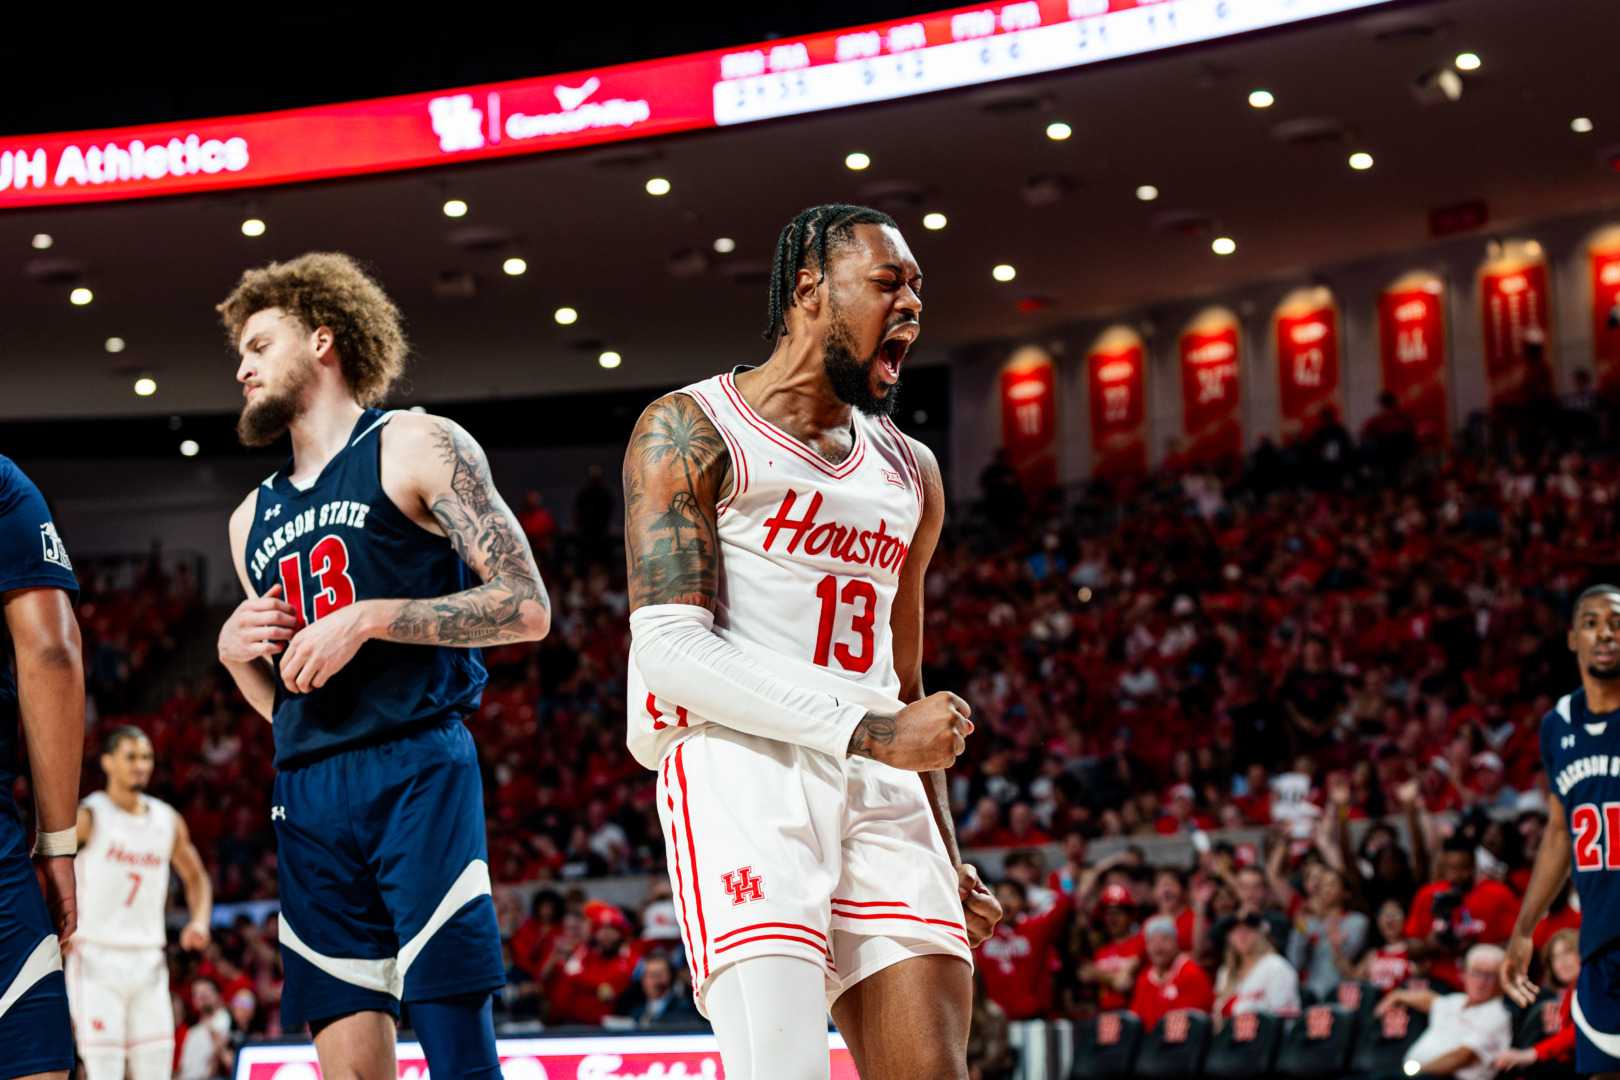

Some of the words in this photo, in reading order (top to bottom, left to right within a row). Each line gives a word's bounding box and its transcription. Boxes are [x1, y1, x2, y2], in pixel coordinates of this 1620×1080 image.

[54, 134, 249, 187] Athletics
[250, 508, 316, 581] JACKSON
[318, 500, 370, 529] STATE
[762, 488, 909, 577] Houston
[278, 533, 356, 627] 13
[812, 574, 878, 674] 13
[1555, 755, 1609, 796] JACKSON
[123, 872, 144, 908] 7
[720, 865, 767, 906] UH
